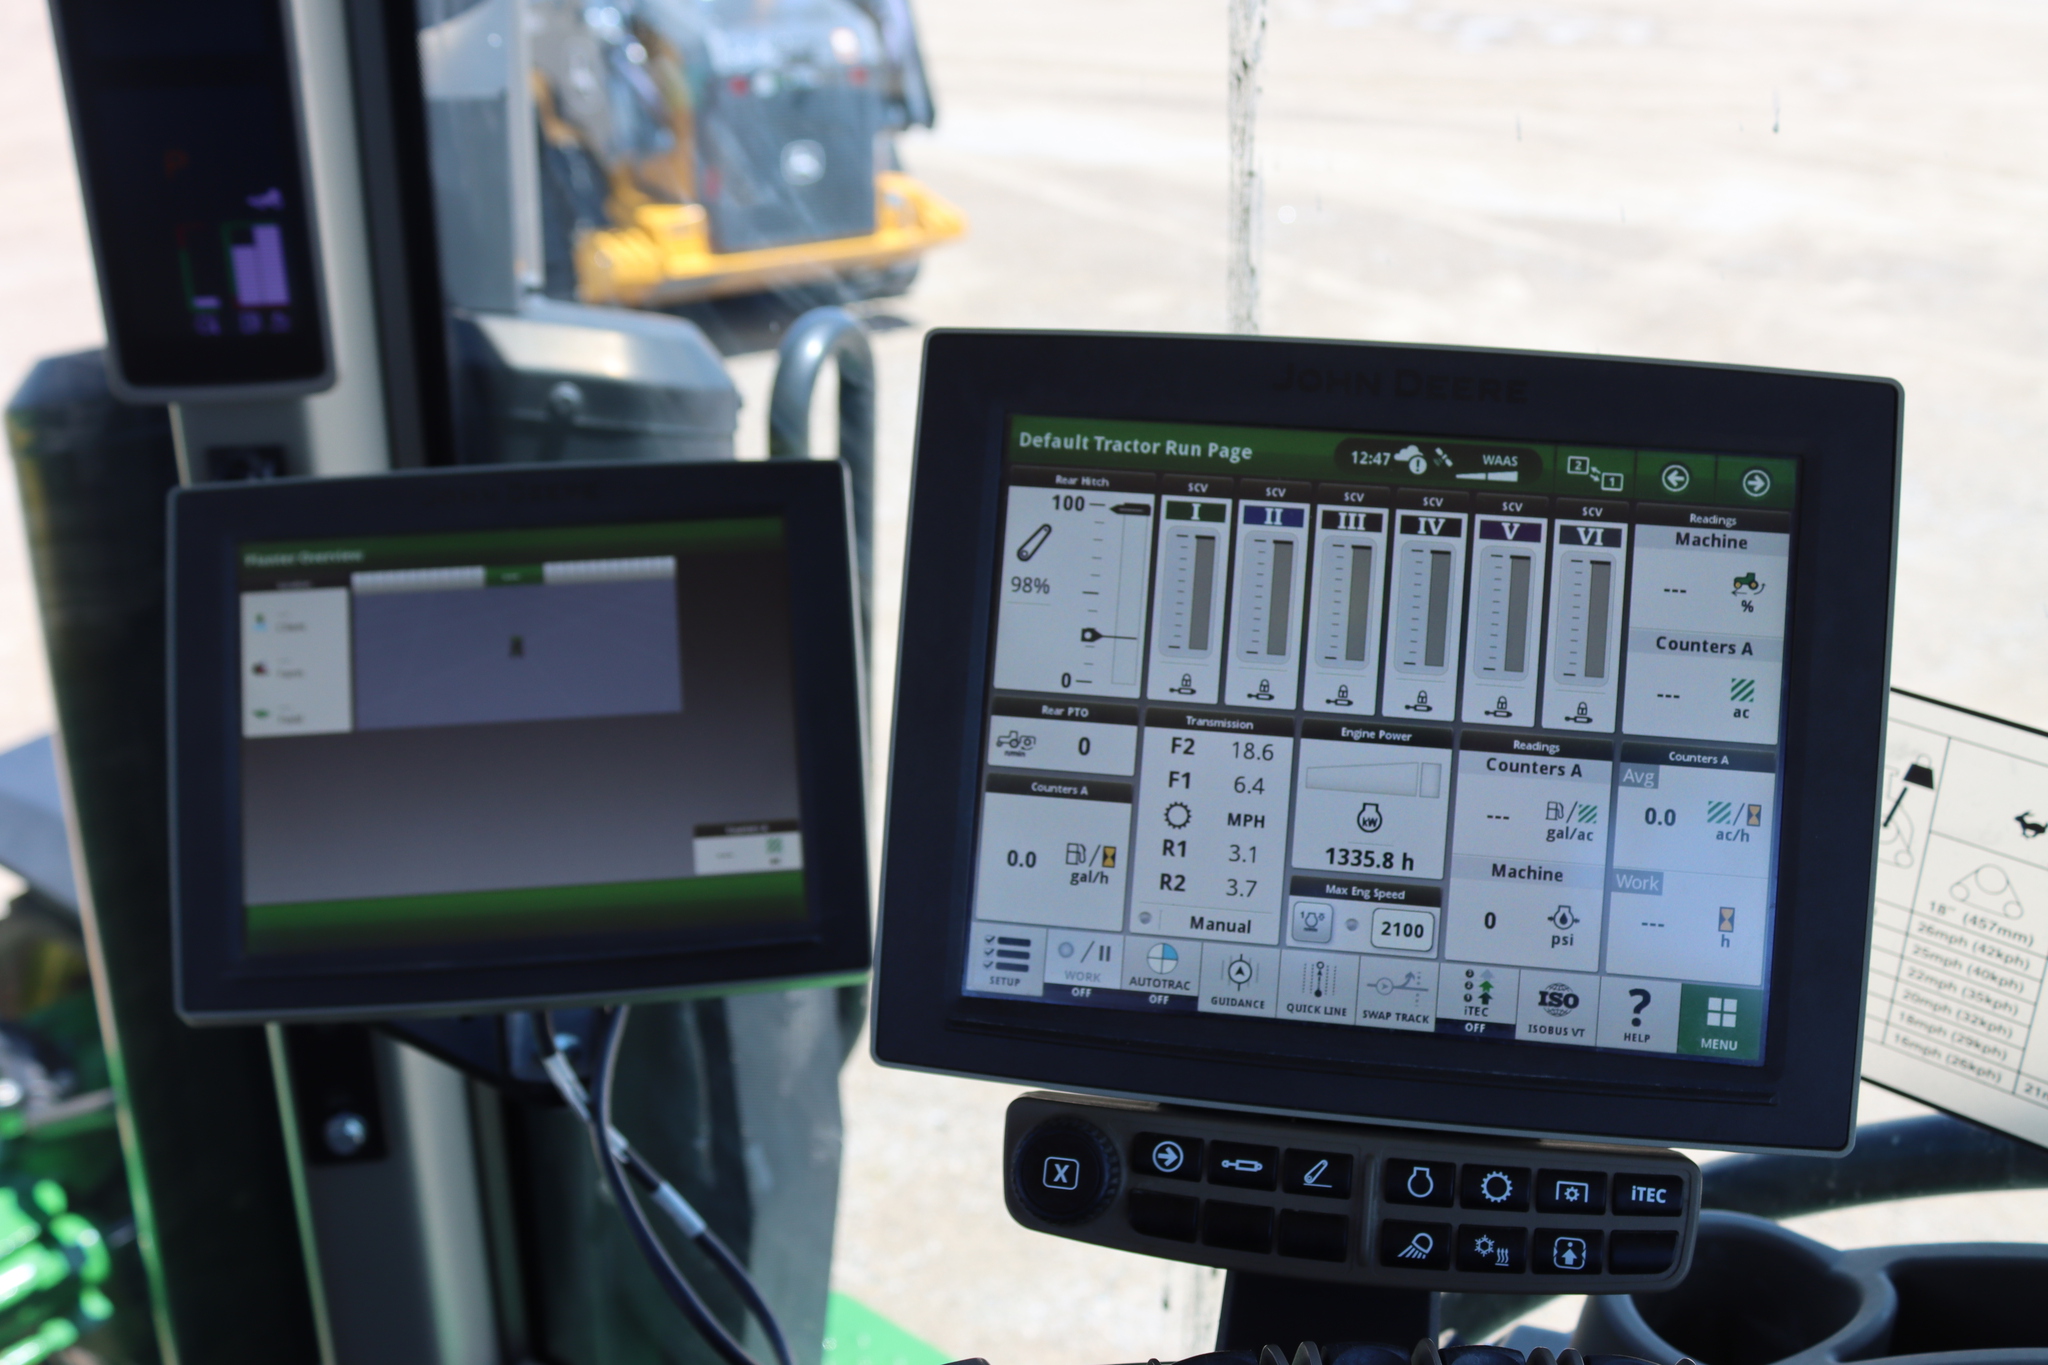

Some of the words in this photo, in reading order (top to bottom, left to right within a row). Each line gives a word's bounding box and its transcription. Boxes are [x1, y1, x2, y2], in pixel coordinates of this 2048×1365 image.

[1272, 362, 1382, 397] JOHN
[1394, 368, 1530, 404] DEERE
[1018, 431, 1090, 452] Default
[1093, 435, 1162, 455] Tractor
[1165, 438, 1202, 457] Run
[1207, 442, 1253, 464] Page
[1351, 450, 1391, 466] 12:47
[1482, 454, 1519, 467] WAAS
[1055, 474, 1079, 487] Rear
[1081, 475, 1110, 488] Hitch
[1187, 481, 1209, 494] SCV
[1265, 485, 1287, 498] SCV
[1343, 491, 1365, 503] SCV
[1052, 494, 1086, 512] 100
[1422, 496, 1444, 508] SCV
[1502, 501, 1523, 513] SCV
[1190, 502, 1202, 520] I
[1264, 507, 1284, 526] II
[1582, 506, 1603, 517] SCV
[1337, 511, 1367, 531] III
[1417, 516, 1446, 536] IV
[1689, 513, 1737, 528] Readings
[1501, 522, 1521, 540] V
[1576, 526, 1605, 546] VI
[1675, 531, 1748, 549] Machine
[1010, 576, 1051, 595] 98%
[1741, 599, 1754, 613] %
[1656, 635, 1737, 655] Counters
[1741, 642, 1754, 656] A
[1060, 672, 1072, 688] 0
[1041, 705, 1064, 716] Rear
[1067, 706, 1089, 718] PTO
[1733, 707, 1750, 719] ac
[1185, 715, 1254, 730] Transmission
[1341, 727, 1376, 741] Engine
[1378, 729, 1413, 742] Power
[1077, 736, 1091, 756] 0
[1170, 736, 1195, 755] F2
[1231, 741, 1274, 761] 18.6
[1513, 739, 1561, 753] Readings
[1668, 751, 1719, 765] Counters
[1720, 755, 1730, 766] A
[1486, 757, 1566, 777] Counters
[1571, 764, 1583, 778] A
[1168, 771, 1191, 789] F1
[1233, 775, 1265, 795] 6.4
[1622, 768, 1655, 789] Avg
[1031, 782, 1078, 795] Counters
[1080, 785, 1089, 796] A
[1227, 812, 1266, 829] MPH
[1644, 807, 1677, 827] 0.0
[1546, 827, 1594, 842] gal/ac
[1715, 827, 1750, 843] ac/h
[1162, 839, 1187, 858] R1
[1228, 844, 1257, 864] 3.1
[1007, 849, 1037, 868] 0.0
[1325, 847, 1394, 870] 1335.8
[1401, 852, 1414, 871] h
[1069, 869, 1109, 886] gal/h
[1491, 863, 1564, 882] Machine
[1159, 873, 1186, 892] R2
[1225, 878, 1258, 898] 3.7
[1616, 873, 1660, 892] Work
[1325, 884, 1348, 896] Max
[1351, 886, 1371, 900] Eng
[1373, 888, 1406, 900] Speed
[1190, 915, 1252, 934] Manual
[1484, 911, 1497, 930] 0
[1381, 920, 1425, 939] 2100
[1551, 933, 1574, 949] psi
[1720, 934, 1731, 948] h
[989, 976, 1021, 987] SETUP
[1064, 970, 1101, 983] WORK
[1129, 976, 1191, 991] AUTOTRAC
[1071, 987, 1092, 998] OFF
[1148, 994, 1170, 1005] OFF
[1537, 990, 1580, 1010] ISO
[1210, 996, 1266, 1010] GUIDANCE
[1286, 1003, 1321, 1015] QUICK
[1324, 1005, 1347, 1017] LINE
[1464, 1005, 1489, 1017] iTEC
[1362, 1009, 1392, 1021] SWAP
[1395, 1012, 1430, 1024] TRACK
[1464, 1022, 1486, 1033] OFF
[1528, 1024, 1569, 1037] ISOBUS
[1571, 1027, 1586, 1038] VT
[1623, 1032, 1651, 1043] HELP
[1700, 1037, 1738, 1051] MENU
[1053, 1163, 1070, 1183] X
[1631, 1185, 1667, 1204] iTEC
